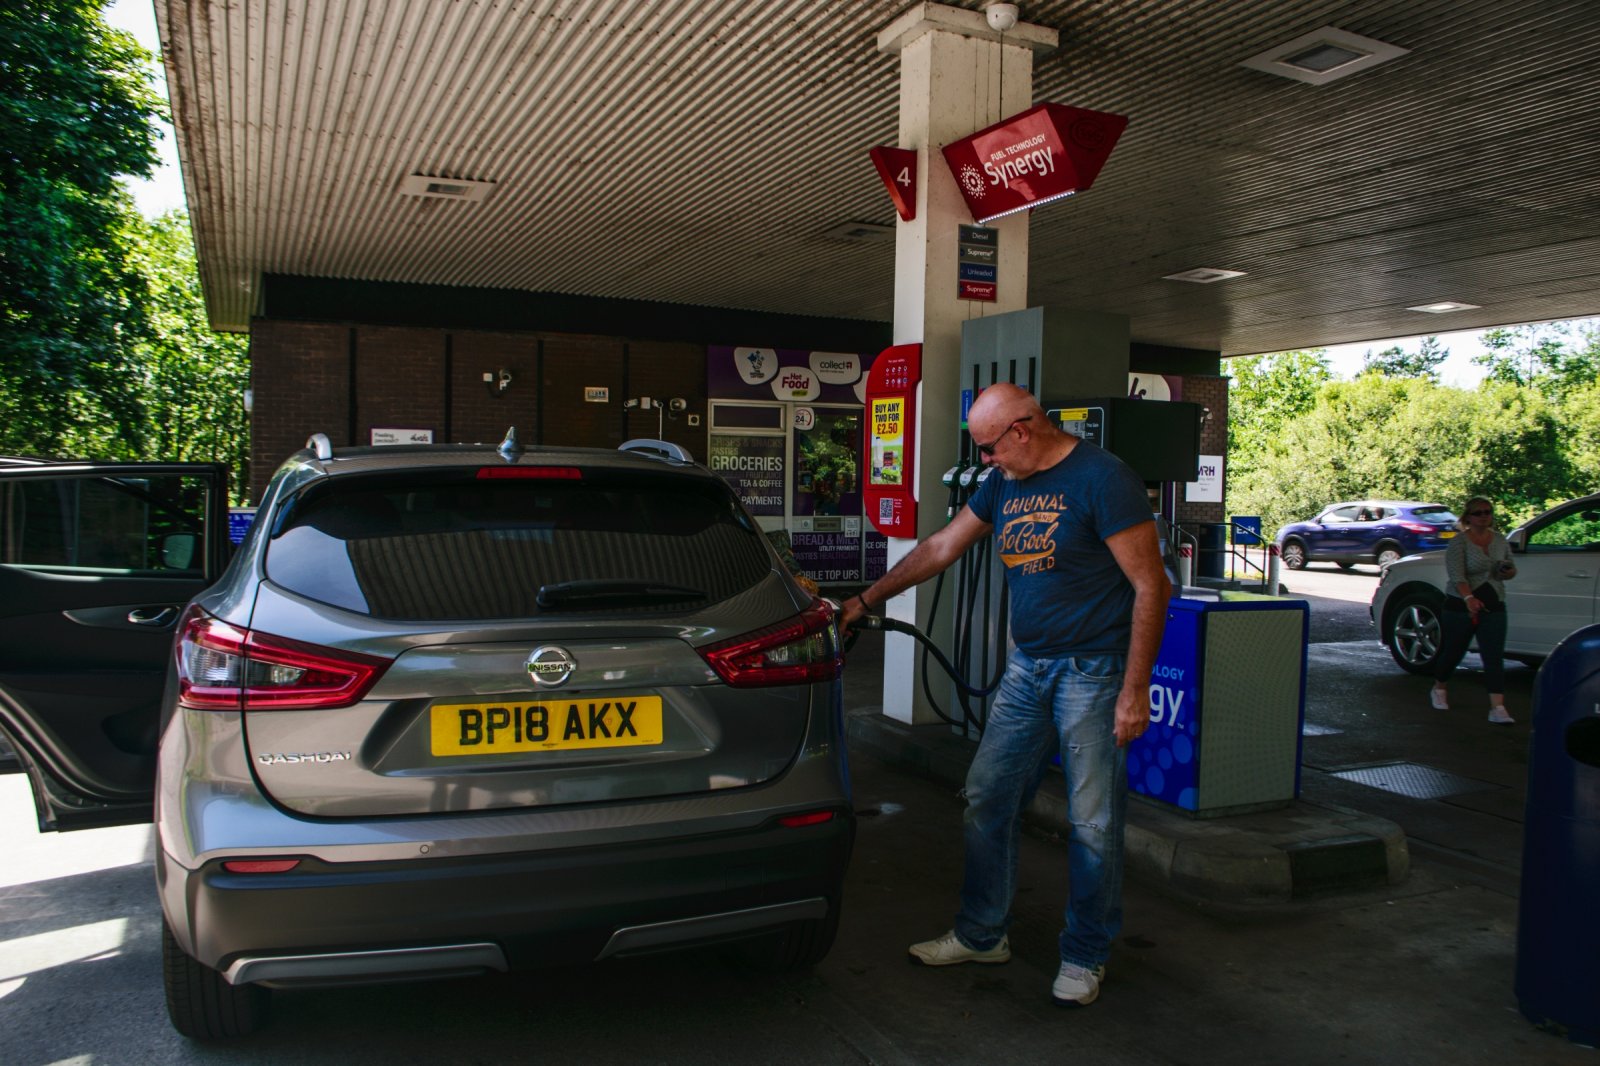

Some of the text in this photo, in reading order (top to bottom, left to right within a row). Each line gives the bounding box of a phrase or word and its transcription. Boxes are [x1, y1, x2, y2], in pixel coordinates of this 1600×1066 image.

[990, 133, 1046, 161] FUEL TECHNOLOGY
[983, 146, 1055, 189] Synergy
[896, 166, 911, 187] 4
[972, 232, 989, 240] Diesel
[967, 268, 993, 277] Unleaded
[782, 376, 809, 389] Food
[874, 402, 900, 414] BUY ANY
[795, 415, 805, 423] 24
[875, 413, 900, 423] TWO FOR
[877, 423, 898, 435] £2.50
[711, 447, 738, 456] PASTIES
[711, 456, 783, 471] GROCERIES
[741, 496, 783, 505] PAYMENTS
[895, 515, 901, 525] 4
[1236, 525, 1256, 534] Exit
[793, 534, 824, 546] BREAD
[826, 534, 833, 545] &
[825, 570, 841, 580] TOP
[842, 570, 859, 580] UPS
[533, 663, 571, 671] NISSAN
[458, 702, 637, 746] BP18 AKX
[258, 751, 351, 766] QASHQAI
